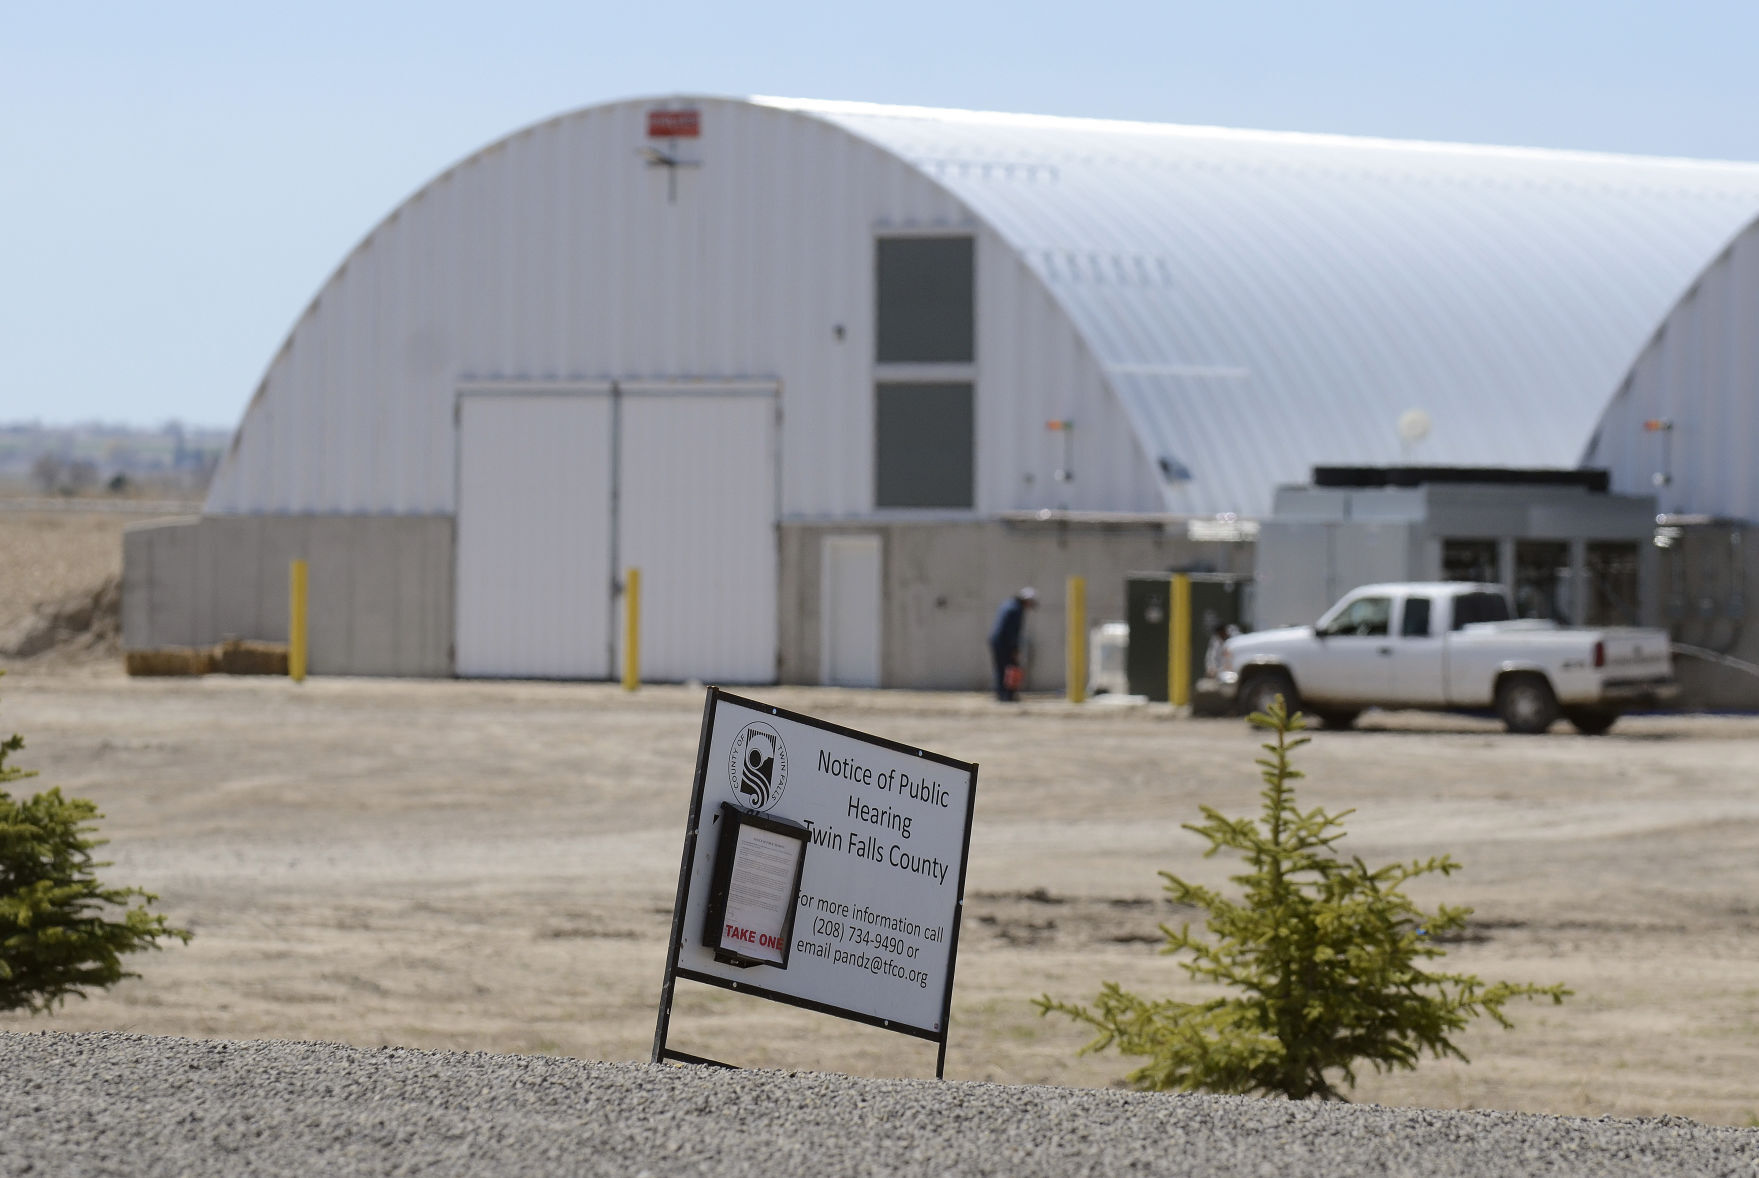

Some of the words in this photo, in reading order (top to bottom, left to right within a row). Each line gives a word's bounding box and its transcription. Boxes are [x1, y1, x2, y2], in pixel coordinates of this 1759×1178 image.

[730, 748, 739, 789] COUNTY
[736, 733, 745, 747] OF
[777, 744, 786, 771] TWIN
[818, 749, 872, 786] Notice
[877, 769, 896, 792] of
[899, 773, 950, 808] Public
[771, 774, 786, 801] FALLS
[847, 795, 912, 839] Hearing
[803, 819, 842, 851] Twin
[848, 832, 884, 863] Falls
[889, 844, 949, 885] County
[725, 924, 757, 943] TAKE
[759, 933, 785, 951] ONE
[798, 889, 815, 908] or
[816, 897, 849, 918] more
[852, 904, 921, 937] information
[924, 926, 944, 943] call
[812, 916, 845, 943] (208)
[848, 926, 905, 955] 734-9490
[906, 946, 920, 960] or
[796, 940, 832, 960] email
[833, 949, 929, 989] pandz@tfco.org
